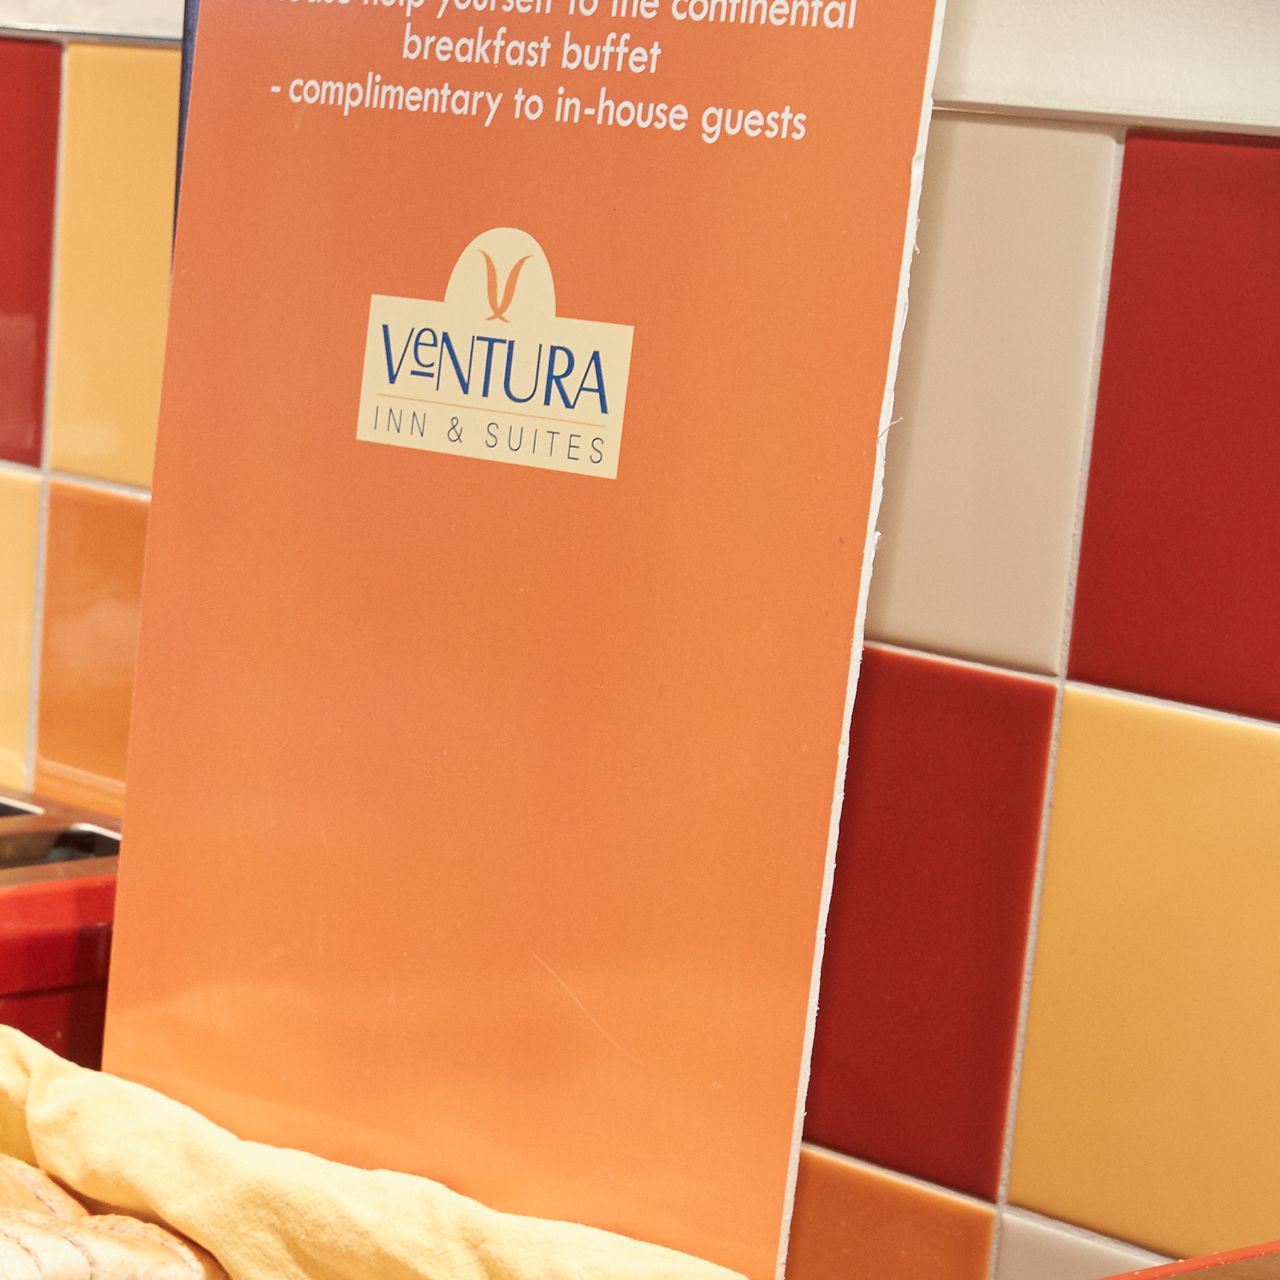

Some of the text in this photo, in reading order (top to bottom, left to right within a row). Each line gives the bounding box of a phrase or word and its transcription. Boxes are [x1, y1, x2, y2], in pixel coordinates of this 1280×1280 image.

[671, 0, 857, 29] continental
[402, 22, 662, 74] breakfast buffet
[288, 71, 503, 128] complimentary
[514, 87, 544, 121] to
[555, 86, 689, 132] in-house
[701, 104, 808, 144] guests
[373, 405, 605, 465] INN & SUITES
